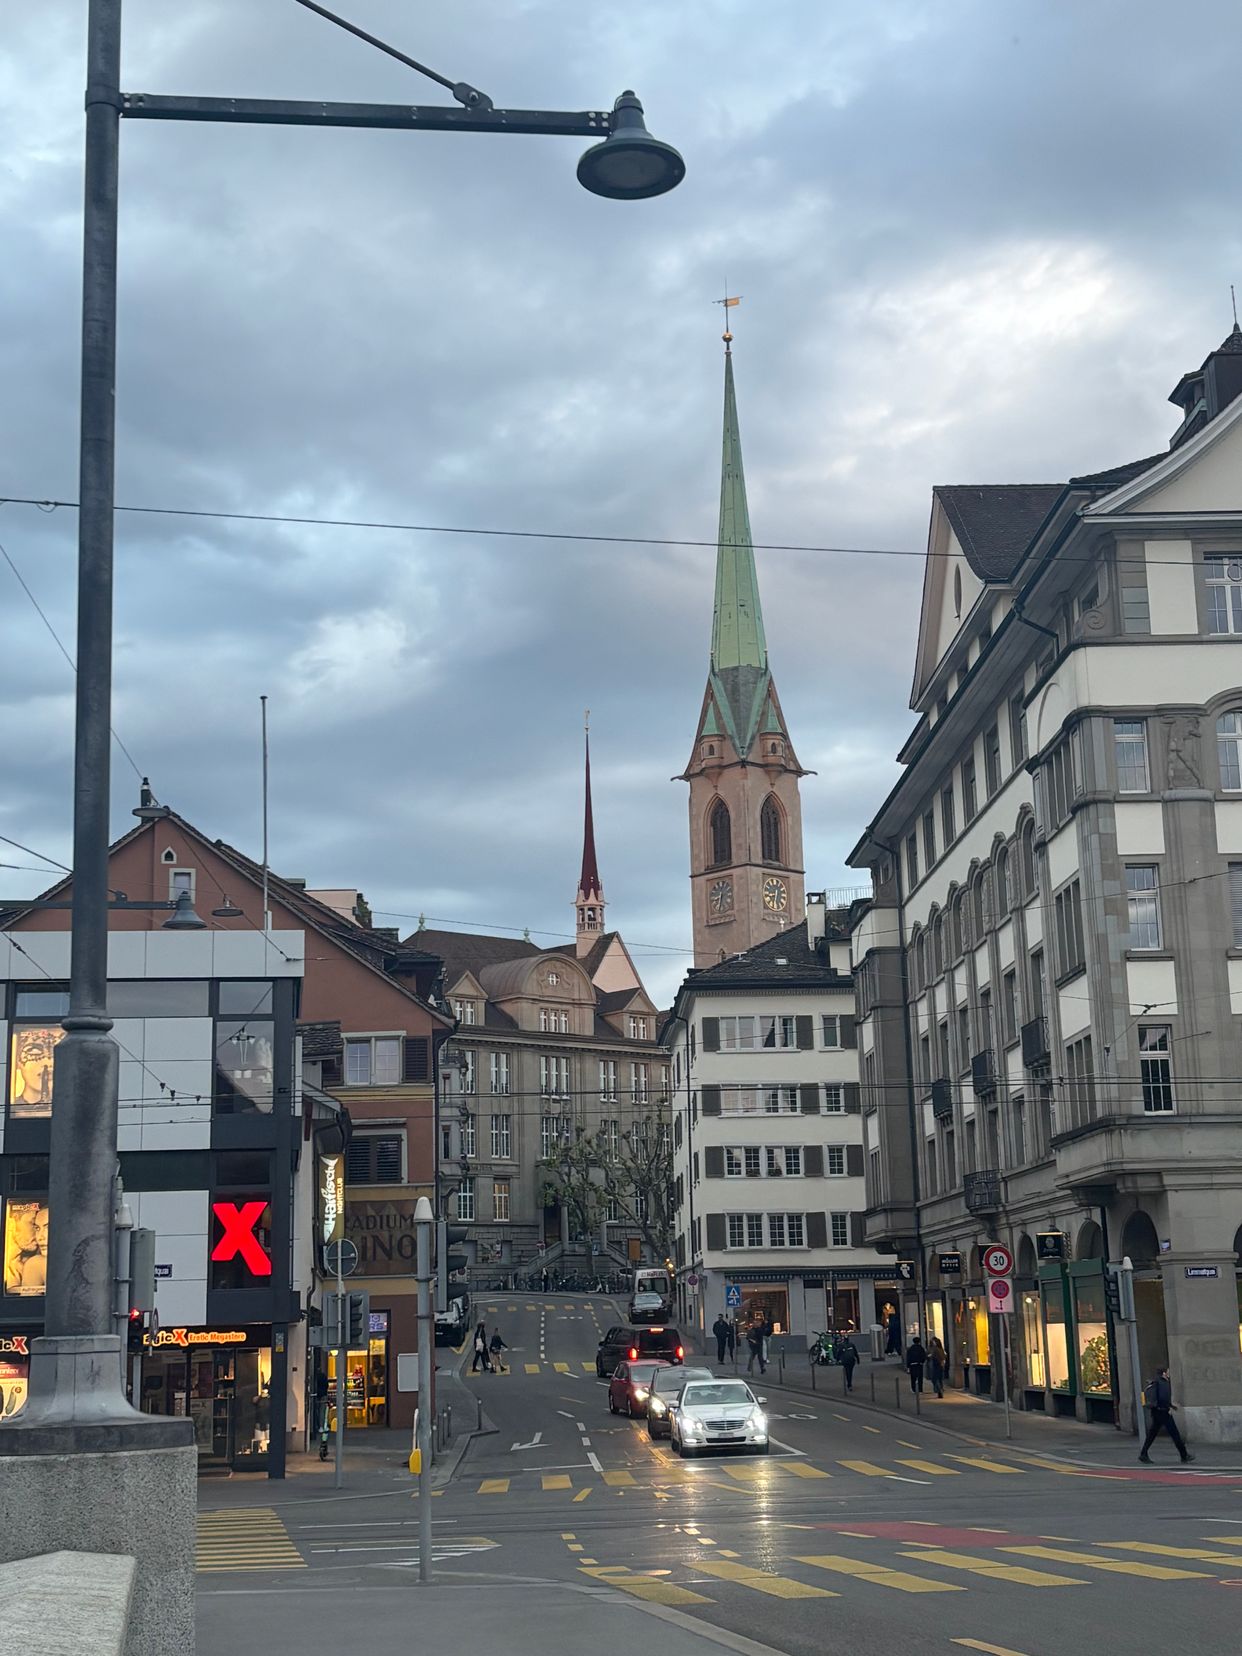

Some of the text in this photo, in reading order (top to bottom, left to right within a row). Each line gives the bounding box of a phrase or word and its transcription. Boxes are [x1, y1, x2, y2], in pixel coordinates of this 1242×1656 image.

[336, 1177, 344, 1214] NIGHTCLUB
[211, 1201, 272, 1276] X
[353, 1235, 417, 1260] INO
[993, 1255, 1005, 1266] 30
[188, 1333, 209, 1342] Erotic
[210, 1332, 246, 1343] Megastore
